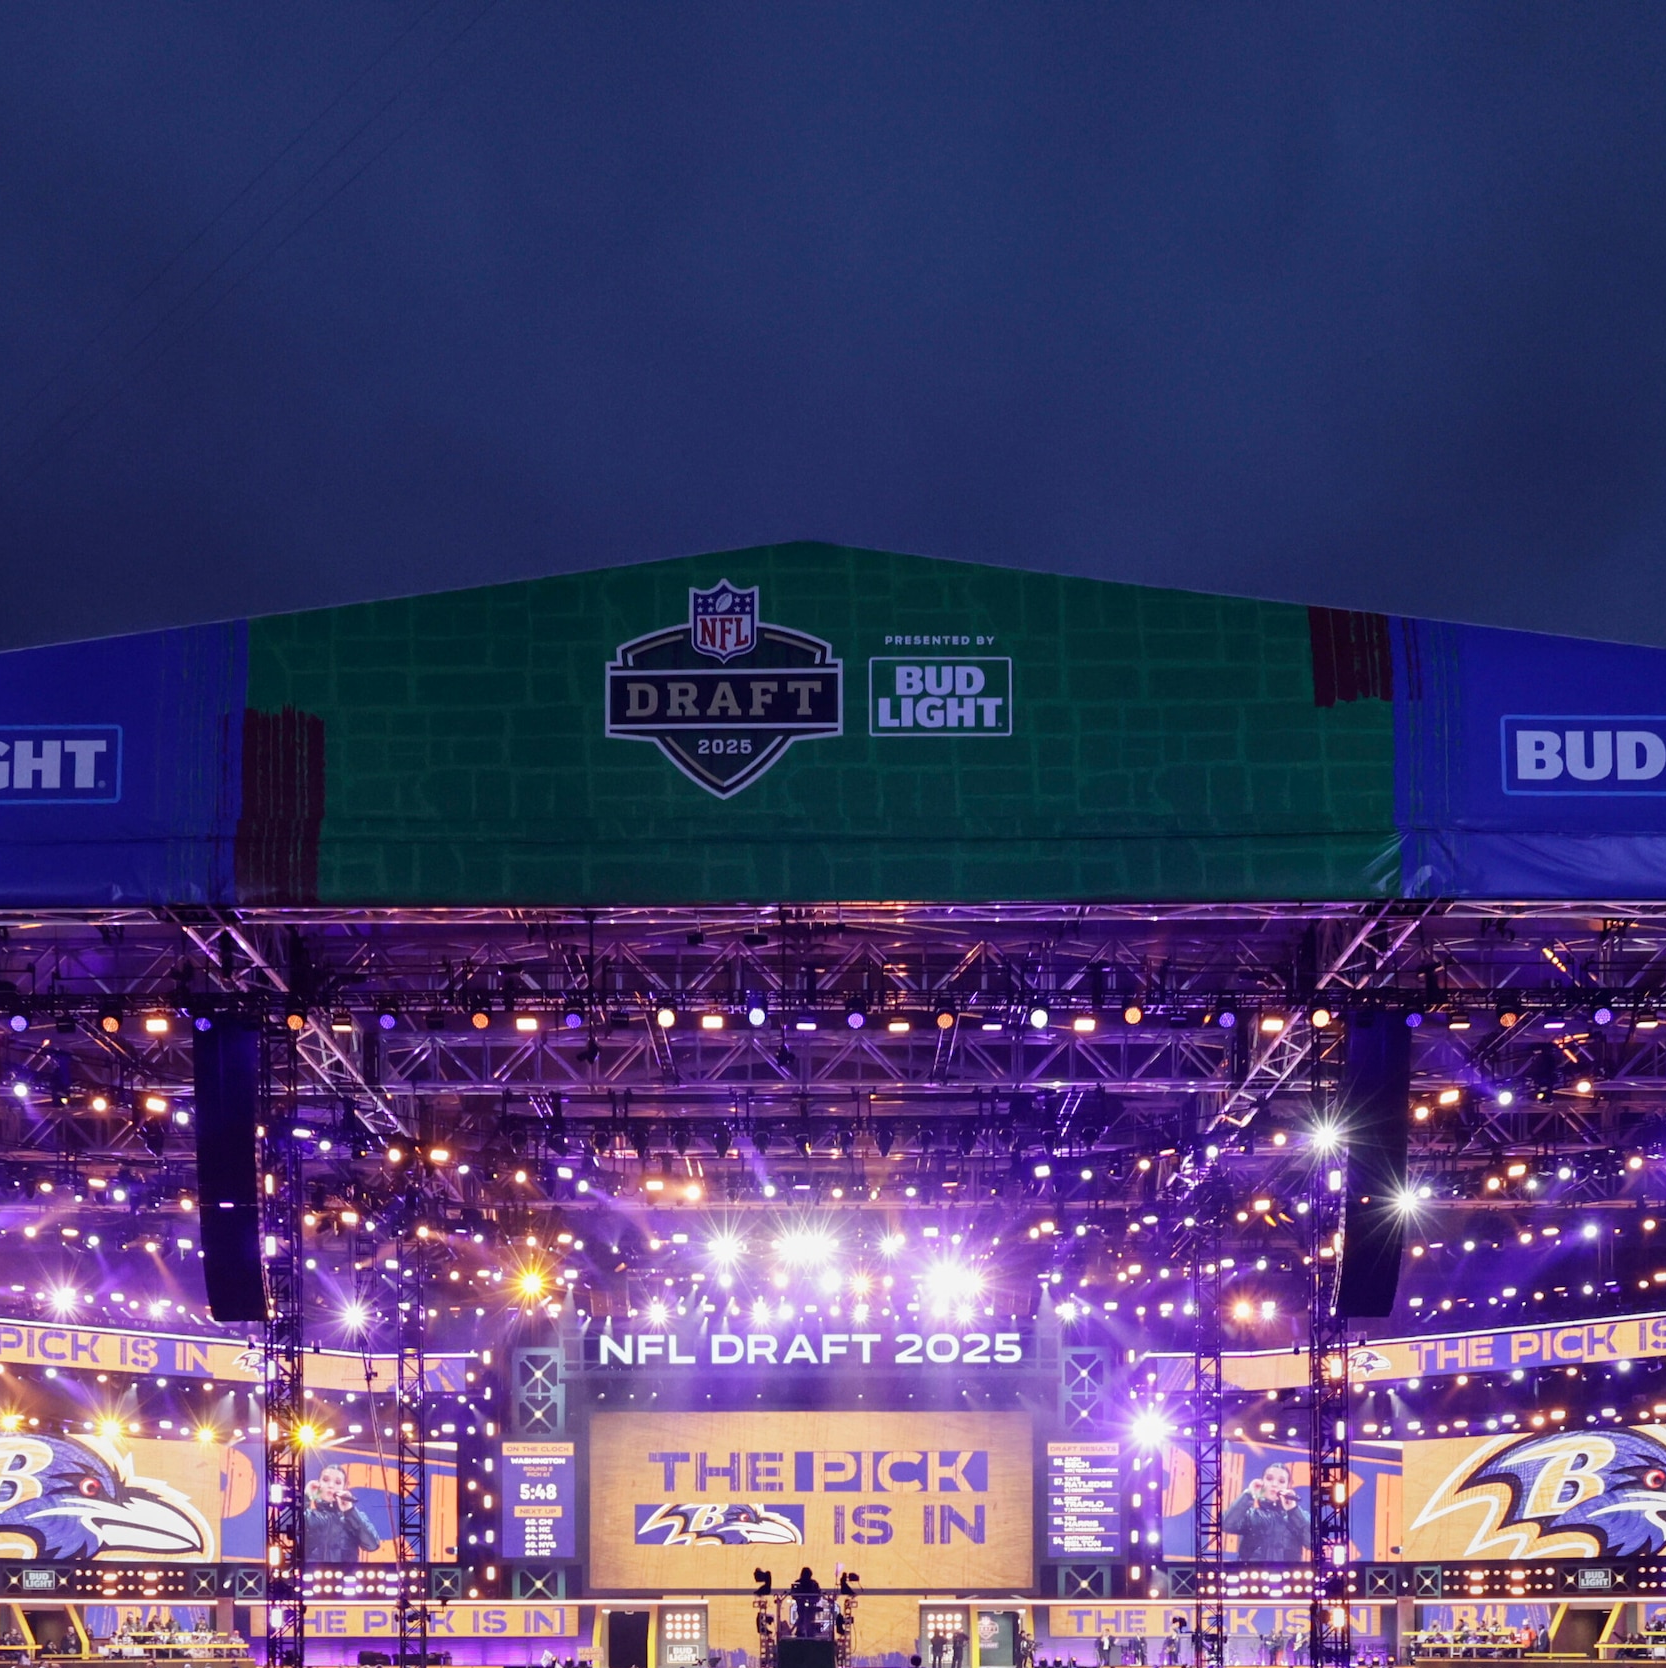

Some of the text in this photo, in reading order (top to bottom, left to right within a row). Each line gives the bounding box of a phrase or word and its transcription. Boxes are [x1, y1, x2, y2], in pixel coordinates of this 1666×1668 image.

[699, 617, 748, 648] NFL
[885, 636, 995, 645] PRESENTED BY
[895, 666, 985, 695] BUD
[626, 681, 822, 717] DRAFT
[878, 697, 1003, 727] LIGHT
[698, 739, 752, 755] 2025
[1516, 730, 1666, 781] BUD
[120, 1337, 158, 1370] IS
[175, 1342, 213, 1374] IN
[599, 1333, 1022, 1365] NFL DRAFT 2025
[1409, 1336, 1493, 1373] THE
[1510, 1325, 1618, 1363] PICK
[511, 1457, 566, 1465] WASHINGTON
[648, 1452, 975, 1492] THE PICK
[519, 1483, 557, 1500] 5:48
[833, 1504, 985, 1545] IS IN
[25, 1579, 54, 1588] LIGHT
[29, 1572, 49, 1580] BUD
[1581, 1577, 1609, 1587] LIGHT
[1585, 1570, 1605, 1578] BUD
[473, 1610, 507, 1633] IS
[1068, 1610, 1146, 1633] THE
